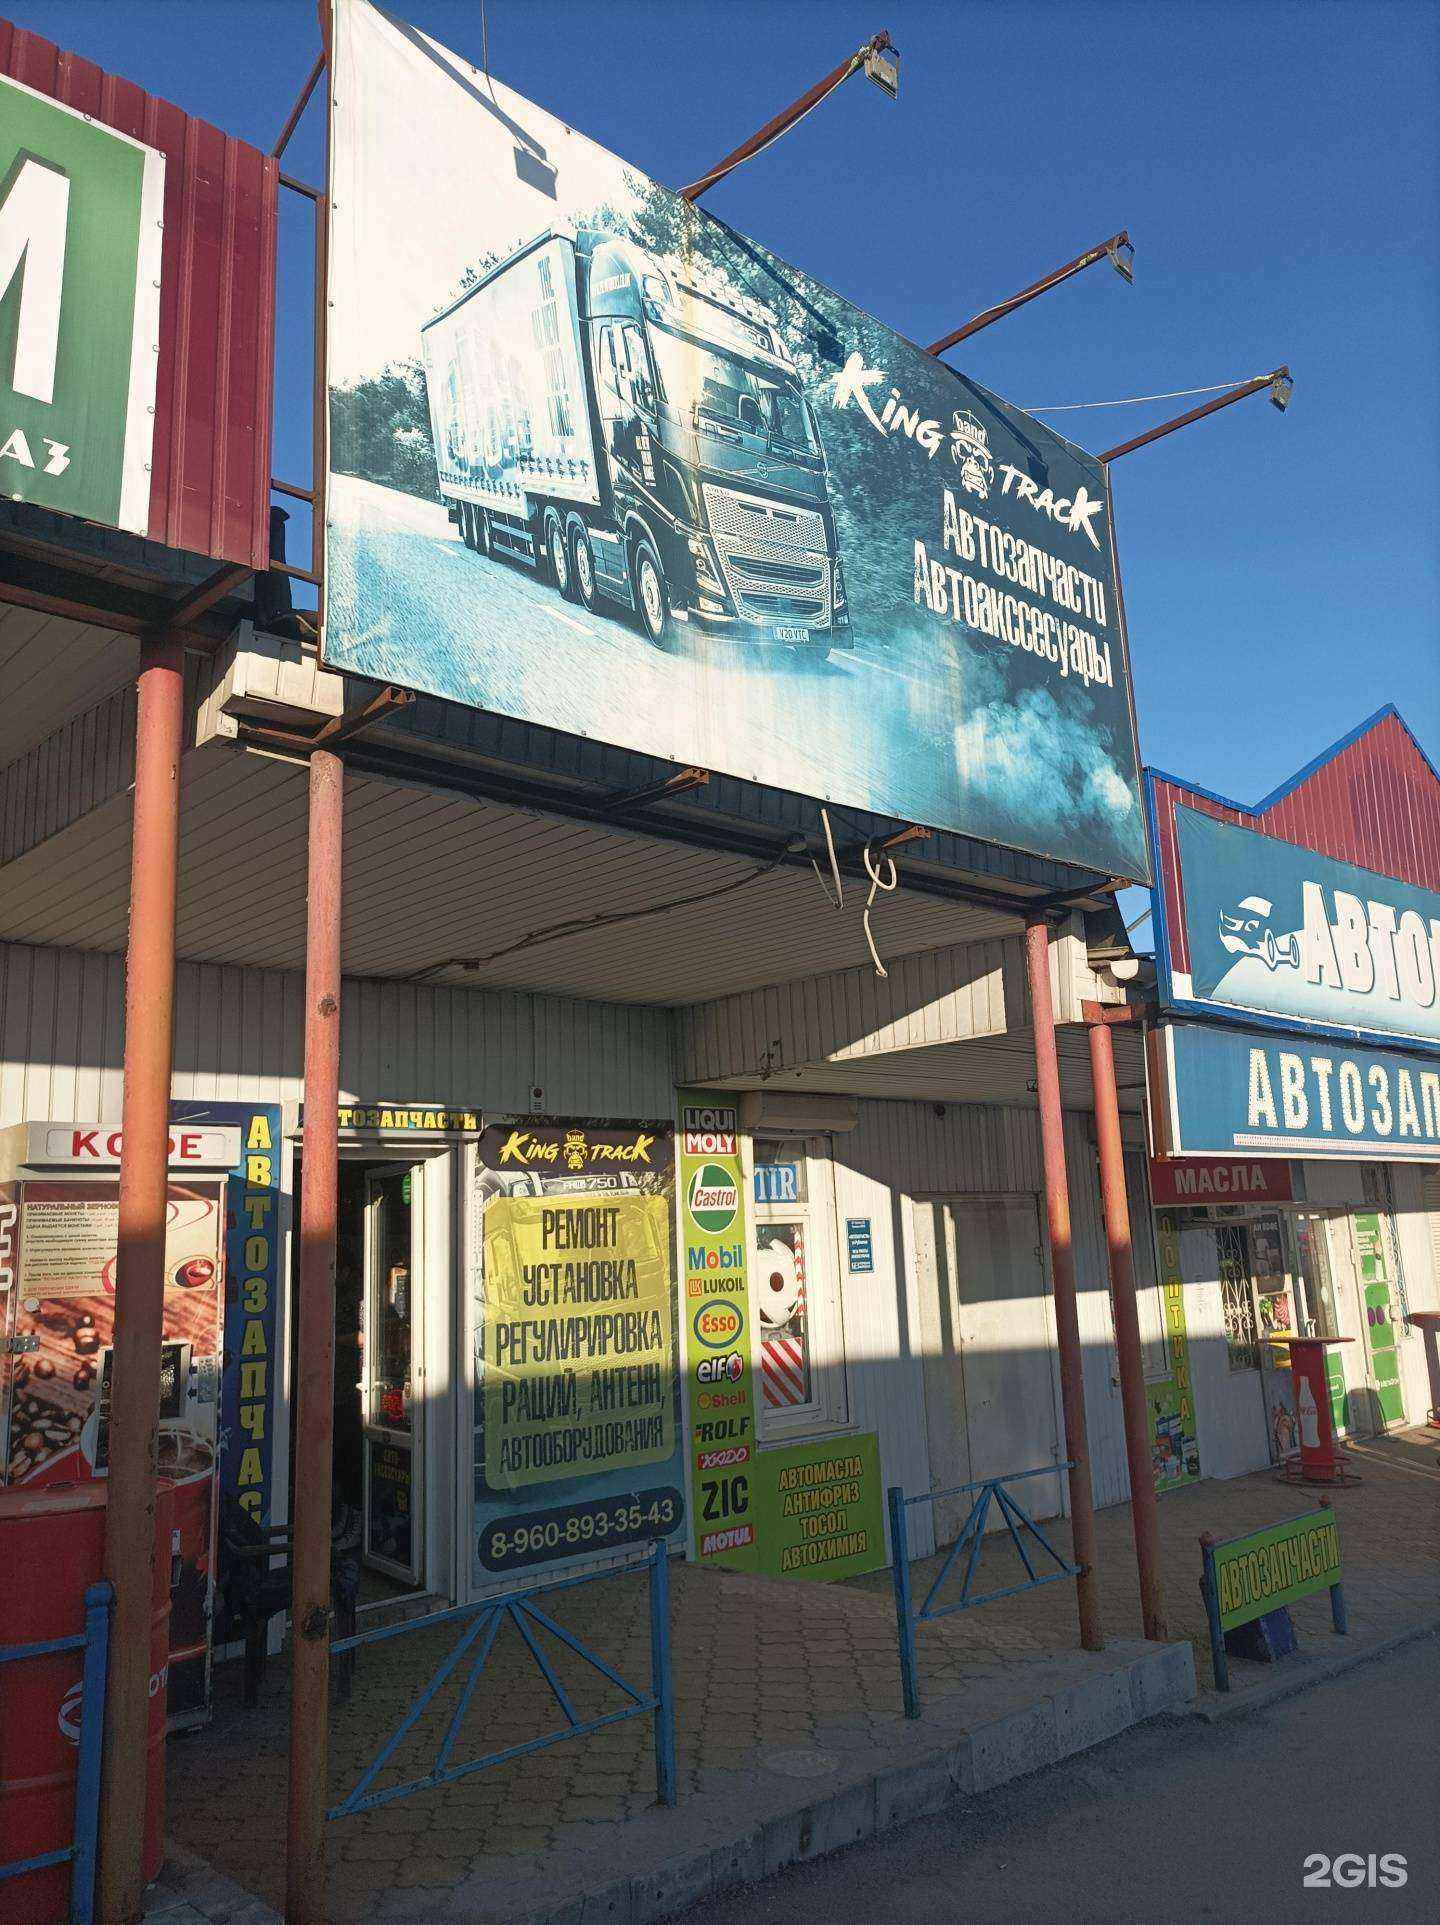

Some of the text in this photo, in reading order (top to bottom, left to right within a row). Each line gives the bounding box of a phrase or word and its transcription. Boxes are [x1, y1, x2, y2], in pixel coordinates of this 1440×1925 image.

[1302, 880, 1440, 1008] АВТО
[300, 1109, 477, 1130] ТОЗАПЧАСТИ
[685, 1109, 734, 1130] LIQUI
[72, 1131, 202, 1158] КОЕ
[686, 1132, 735, 1153] MOLY
[753, 1167, 797, 1200] TIR
[1174, 1165, 1267, 1194] МАСЛА
[694, 1188, 737, 1207] Castrol
[541, 1207, 621, 1250] РЕМОНТ
[688, 1245, 743, 1270] Mobil
[523, 1259, 639, 1307] УСТАНОВКА
[703, 1278, 745, 1293] LUKOIL
[495, 1309, 663, 1367] РЕГУЛИРИРОВКА
[697, 1355, 727, 1384] elf
[502, 1362, 665, 1425] РАЦИЙ, АНТЕНН,
[499, 1415, 664, 1474] АВТООБОРУДОВАНИЯ
[700, 1416, 750, 1442] ROLF
[779, 1456, 862, 1492] АВТОМАСЛА
[702, 1476, 749, 1521] ZIC
[783, 1482, 860, 1517] АНТИФРИЗ
[490, 1499, 674, 1560] 8-960-893-35-43
[702, 1526, 752, 1555] MOTUL
[800, 1509, 848, 1540] ТОСОЛ
[782, 1530, 868, 1572] АВТОХИМИЯ
[1219, 1522, 1340, 1615] АВТОЗАПЧАСТИ
